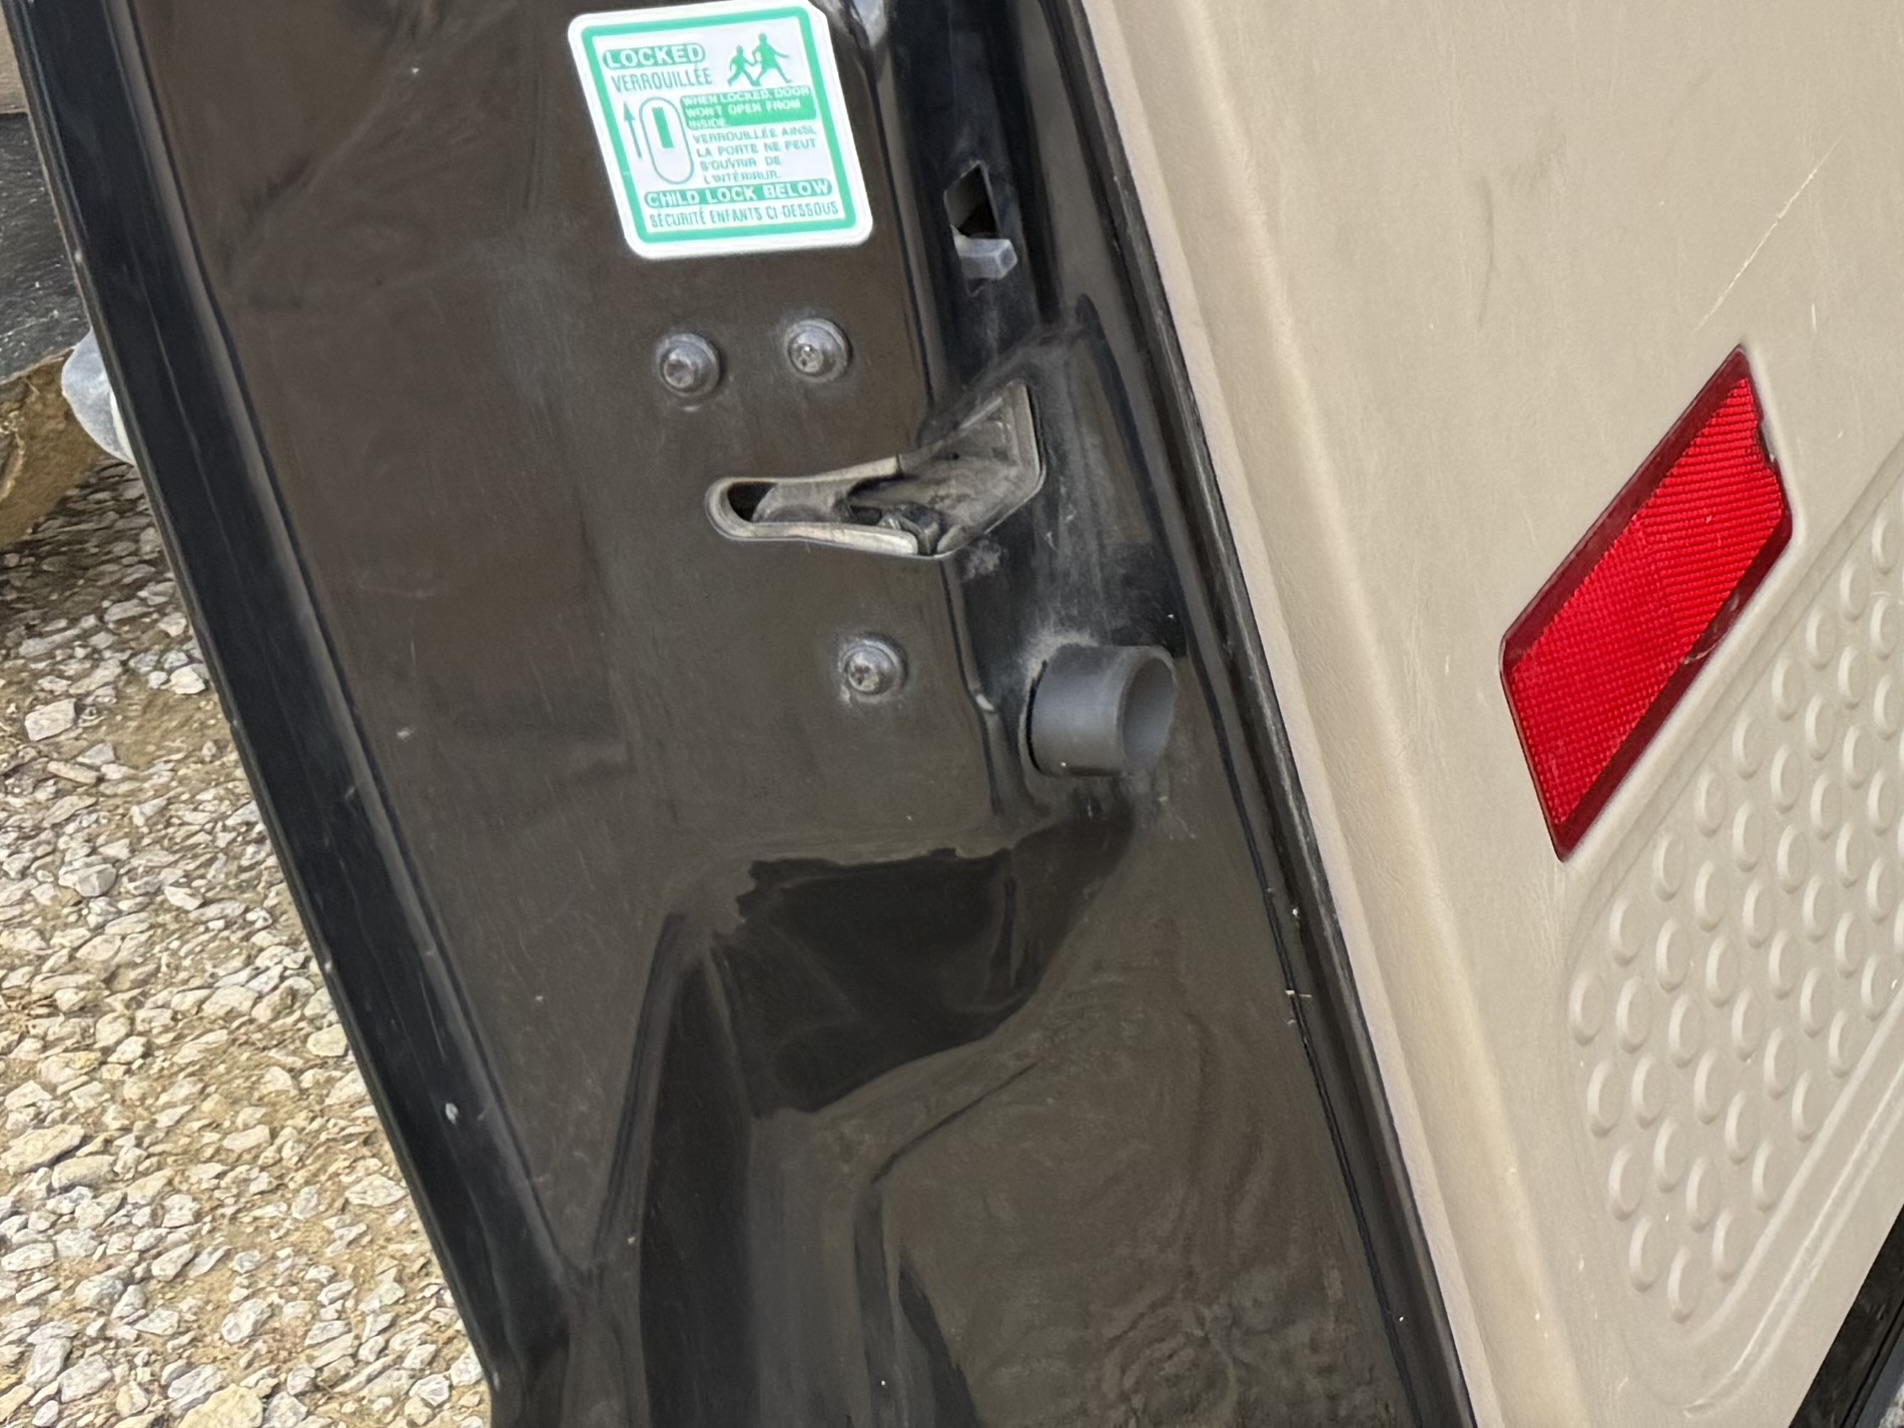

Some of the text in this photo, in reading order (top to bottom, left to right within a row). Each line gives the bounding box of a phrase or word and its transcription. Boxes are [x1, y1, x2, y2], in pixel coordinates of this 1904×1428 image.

[605, 44, 703, 68] LOCKED
[611, 64, 713, 93] VERROUILLÉE
[682, 94, 718, 106] WHEN
[774, 87, 810, 98] DOOR
[727, 102, 762, 115] OPEN
[766, 99, 801, 112] FROM
[692, 126, 778, 144] VERROUILLÉE
[696, 138, 817, 158] LA PORTE NE PEUT
[764, 155, 781, 166] DE
[647, 180, 830, 208] CHILD LOCK BELOW
[649, 206, 706, 228] SÉCURITÉ
[709, 207, 763, 224] ENFANTS
